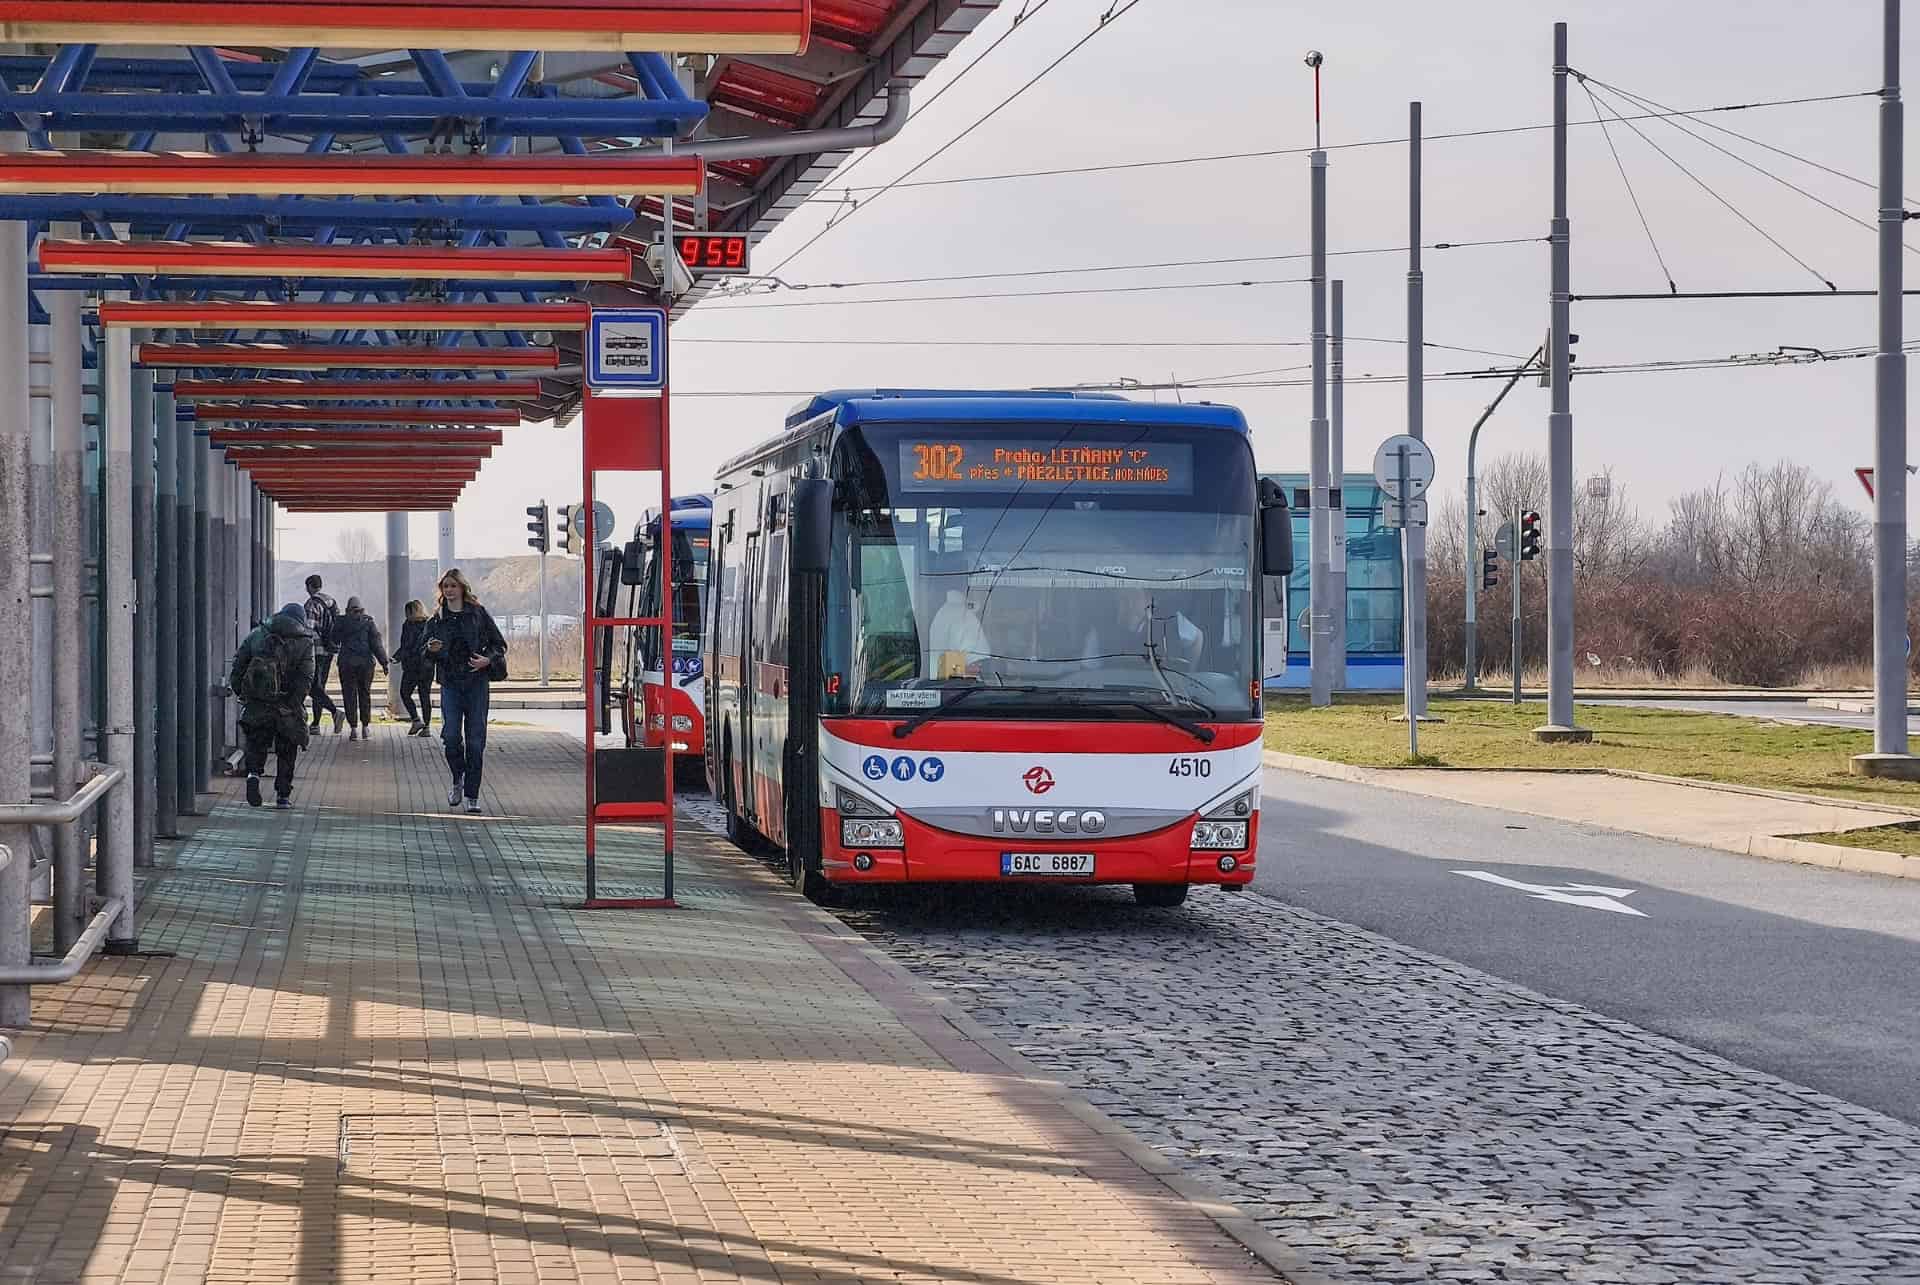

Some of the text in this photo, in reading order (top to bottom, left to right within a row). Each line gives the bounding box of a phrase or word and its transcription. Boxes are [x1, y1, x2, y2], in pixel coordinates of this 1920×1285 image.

[912, 443, 963, 480] 302
[1051, 443, 1124, 464] LETŇANY
[968, 463, 999, 480] přes
[1169, 758, 1211, 777] 4510
[992, 809, 1106, 833] IVECO
[1014, 855, 1041, 870] 6AC
[1052, 855, 1087, 870] 6887
